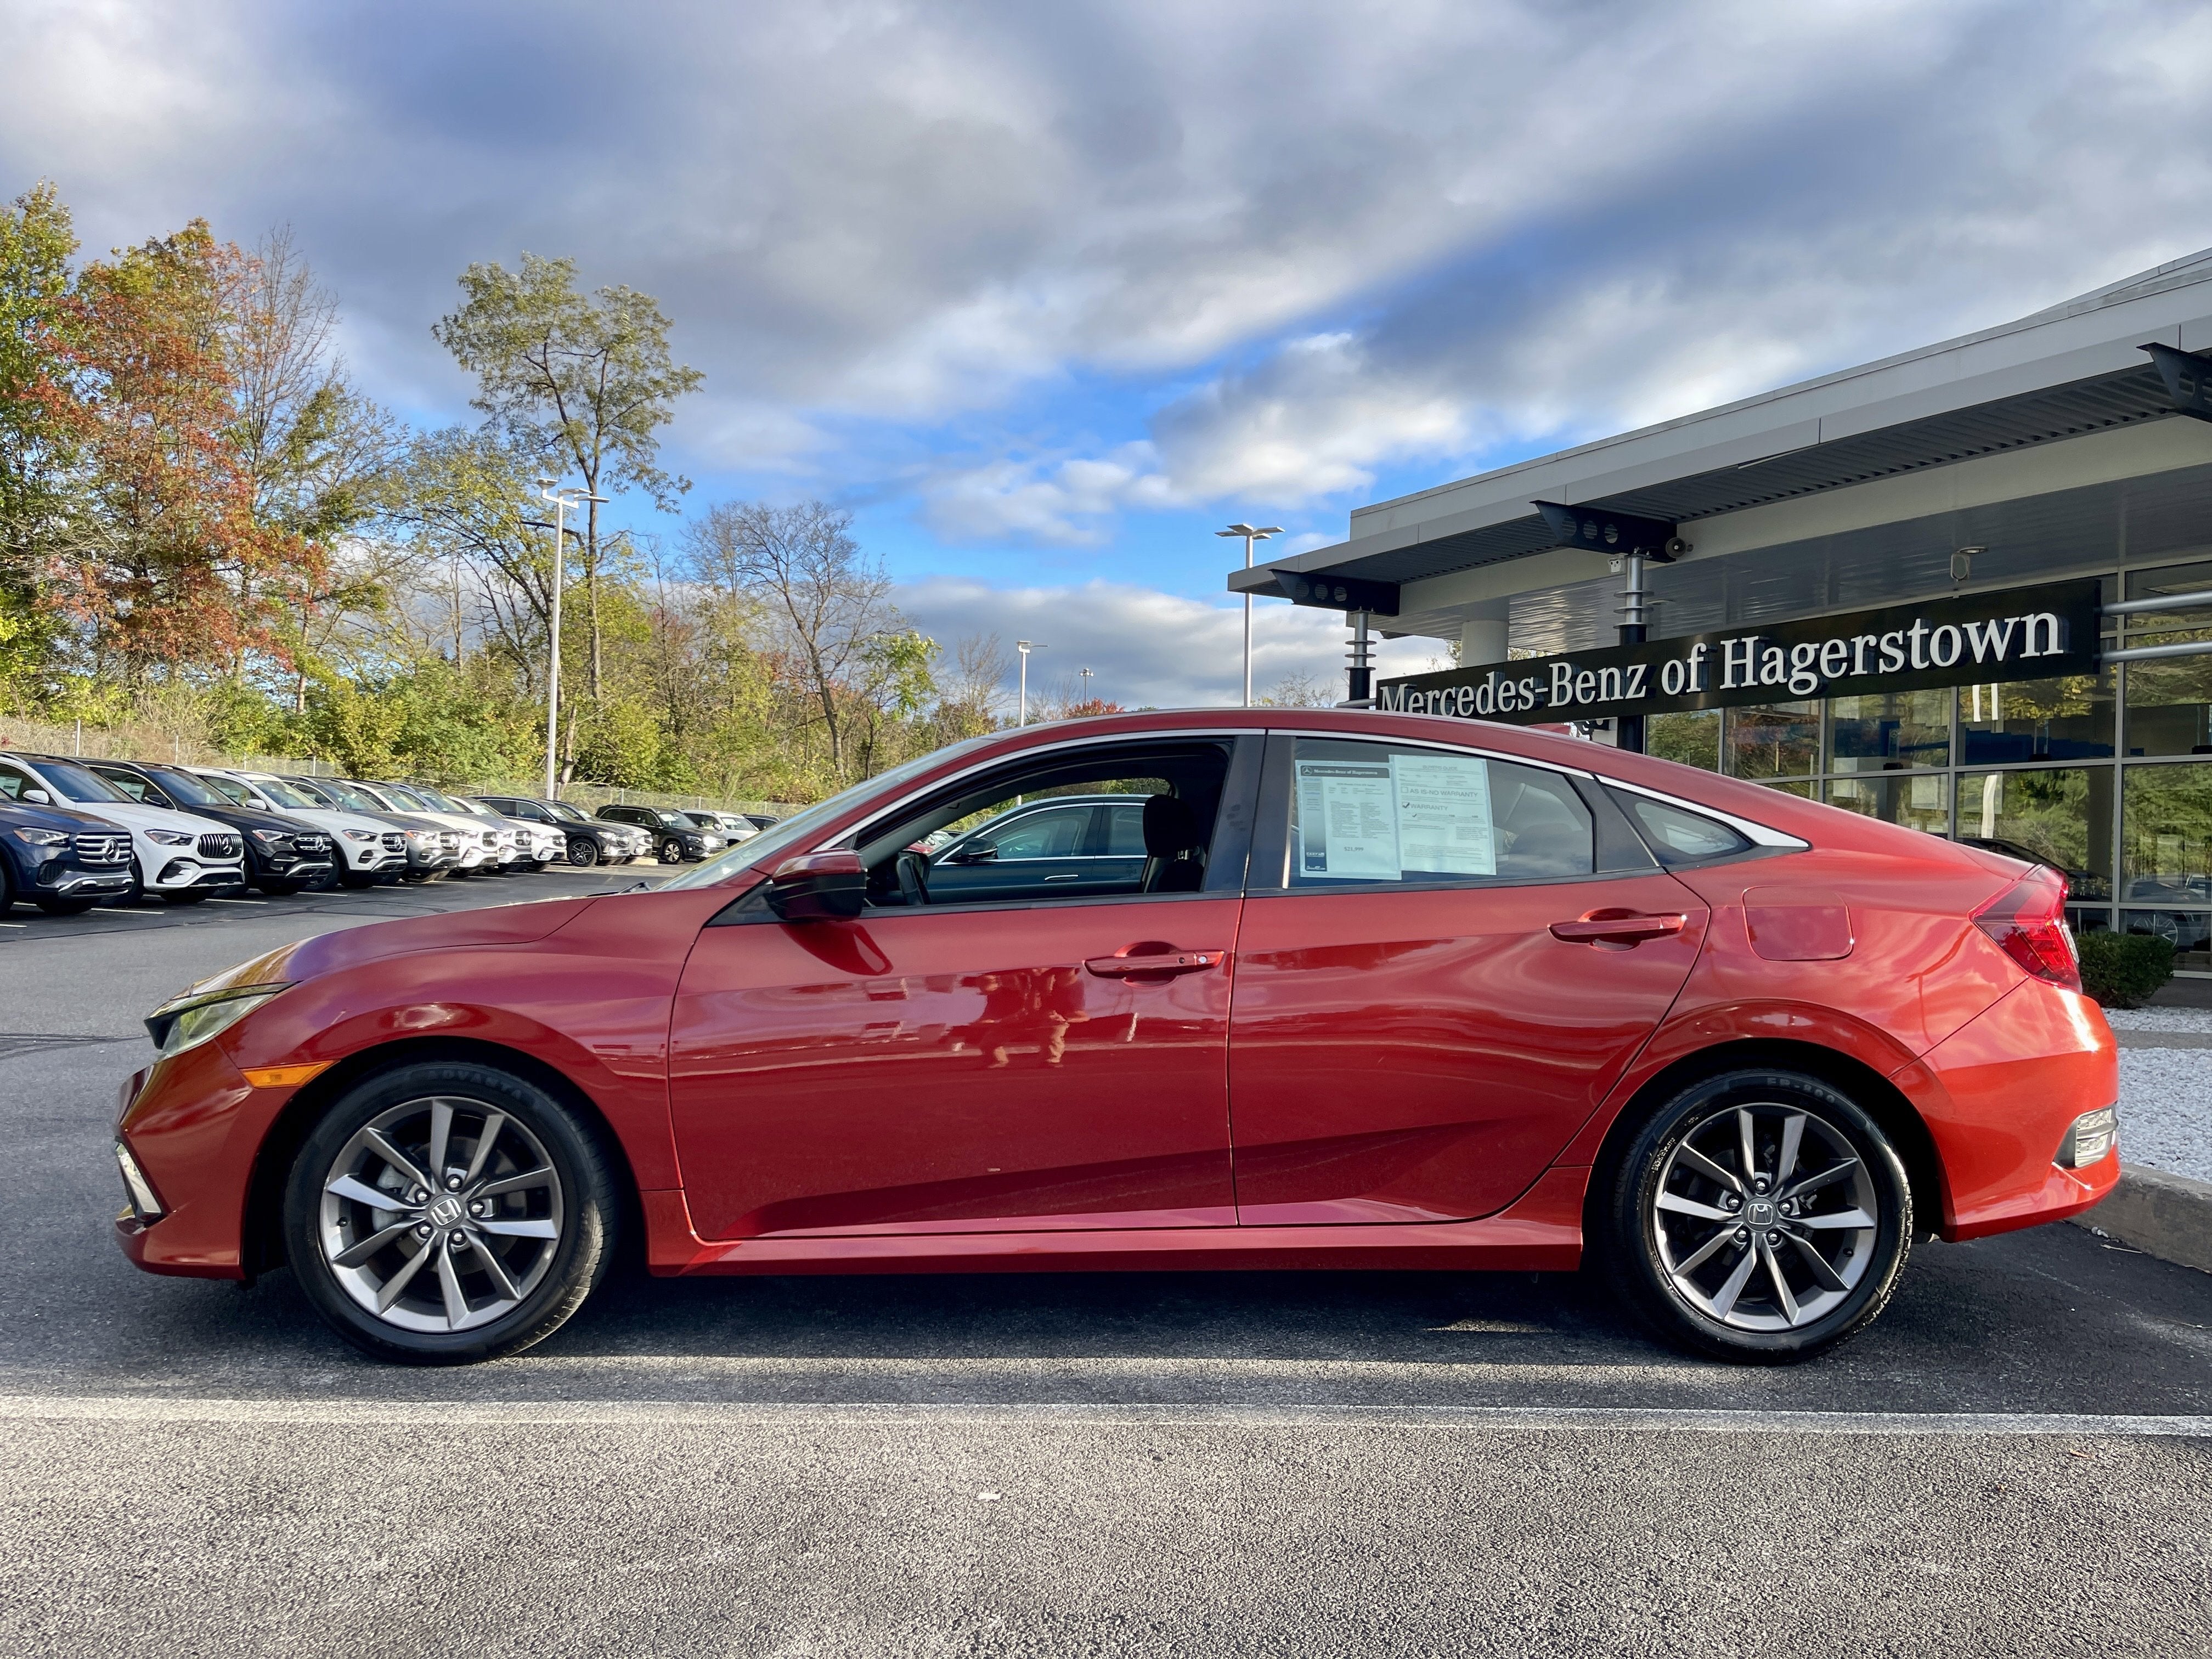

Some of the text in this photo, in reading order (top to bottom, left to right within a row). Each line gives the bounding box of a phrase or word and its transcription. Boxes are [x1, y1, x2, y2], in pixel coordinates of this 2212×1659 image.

[1380, 612, 2064, 717] Mercedes-Benz of Hagerstown
